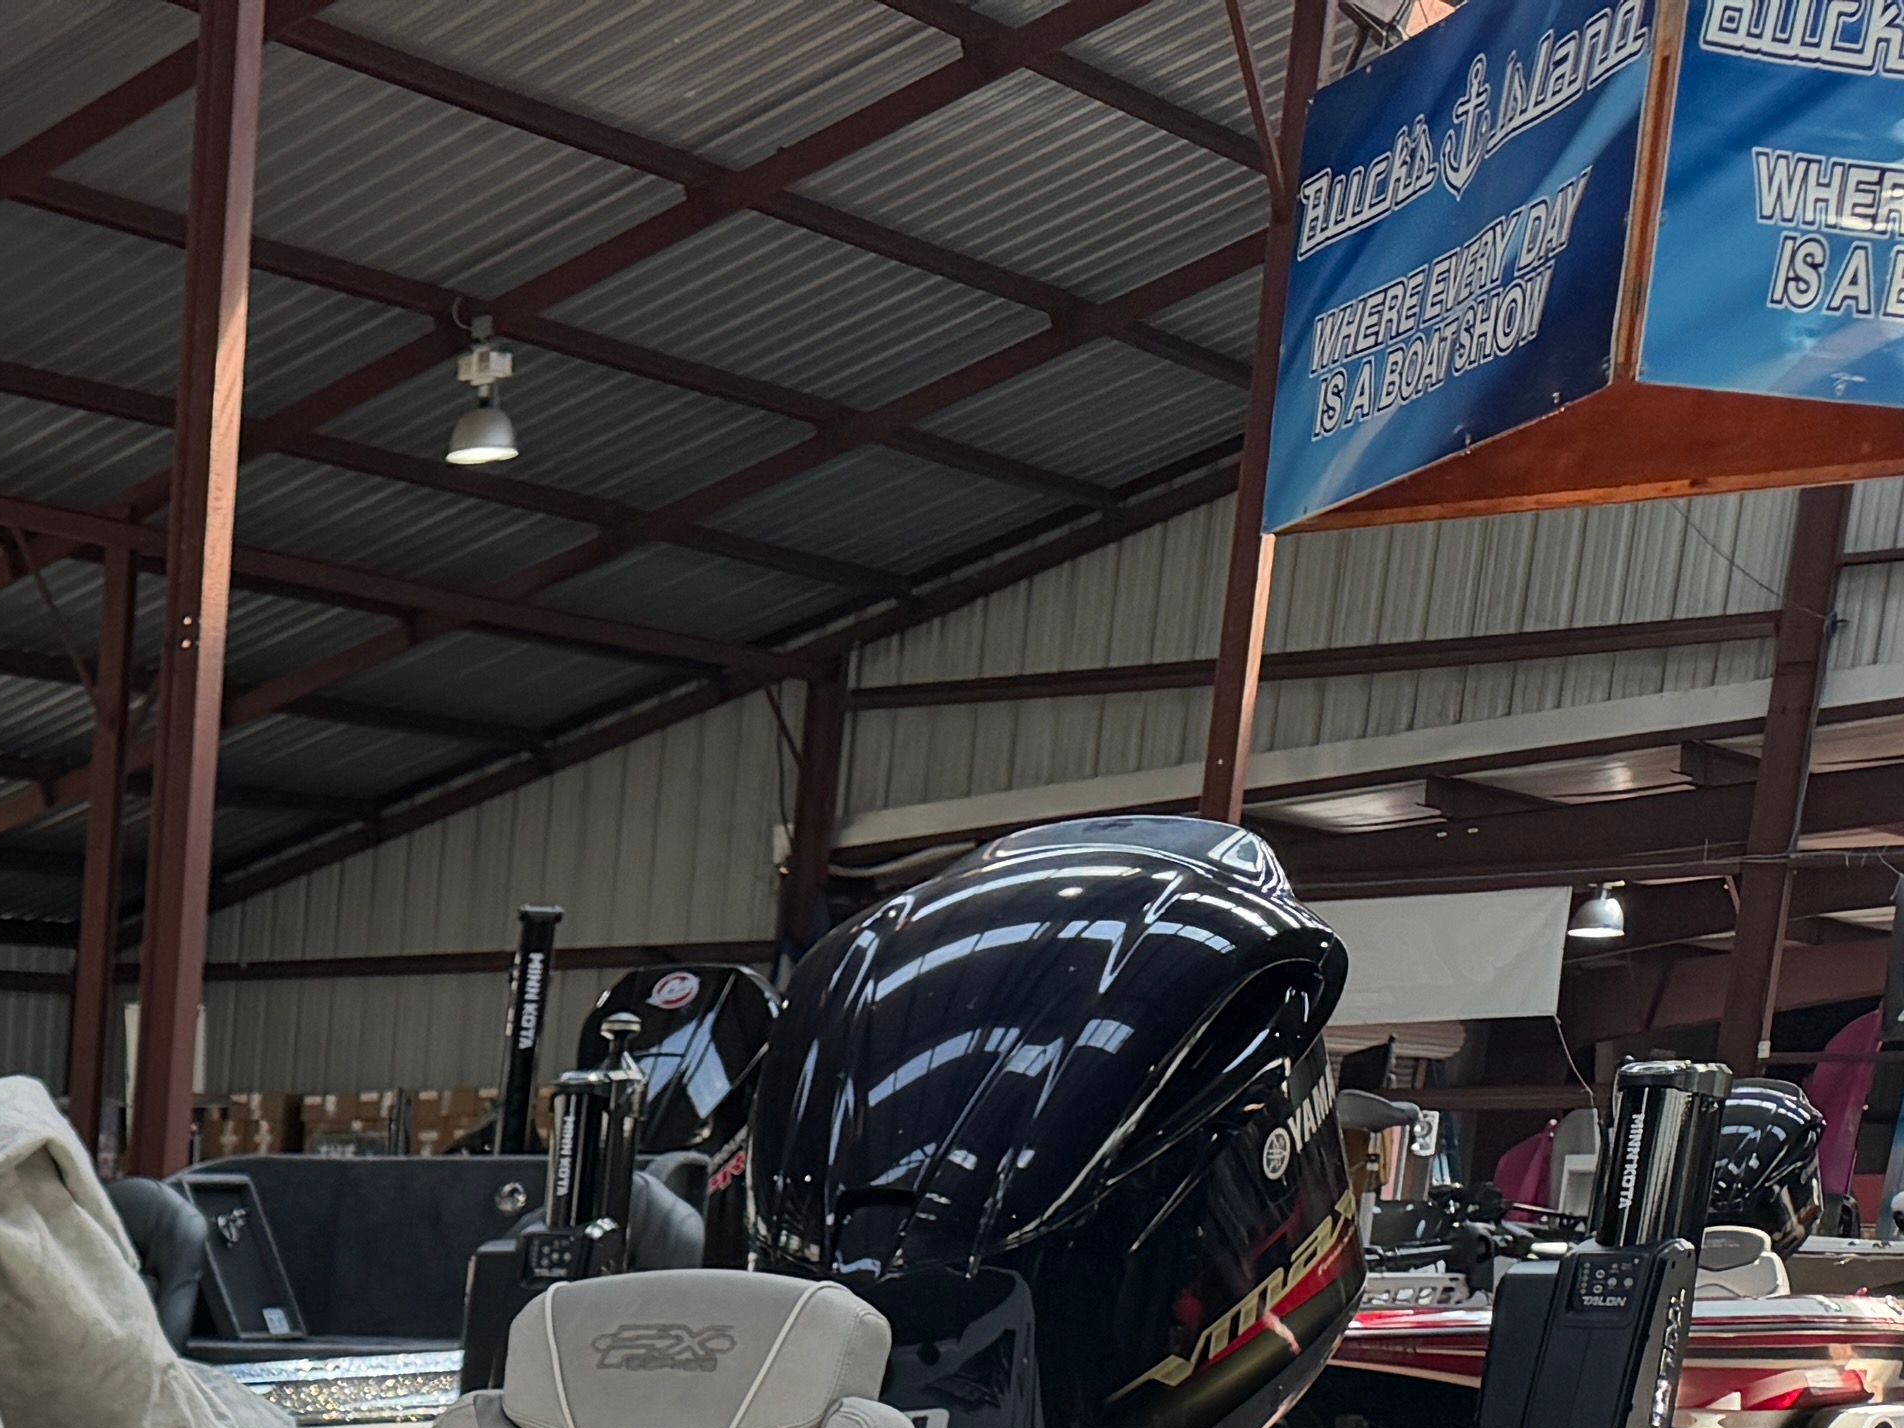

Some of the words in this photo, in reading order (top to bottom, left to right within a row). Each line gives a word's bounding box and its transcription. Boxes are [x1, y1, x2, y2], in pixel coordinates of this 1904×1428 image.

[1309, 264, 1429, 378] WHERE
[1422, 205, 1526, 328] EVERY
[1513, 165, 1592, 276] DAY
[1767, 231, 1830, 313] IS
[1822, 240, 1875, 319] A
[1312, 366, 1347, 441] IS
[1343, 356, 1375, 428] A
[1376, 316, 1460, 414] BOAT
[1451, 259, 1556, 377] SHOW
[524, 952, 545, 1000] MINN
[519, 1002, 539, 1050] KOTA
[1625, 1113, 1645, 1161] MINN
[1617, 1159, 1638, 1209] KOTA
[1582, 1295, 1627, 1308] TALON
